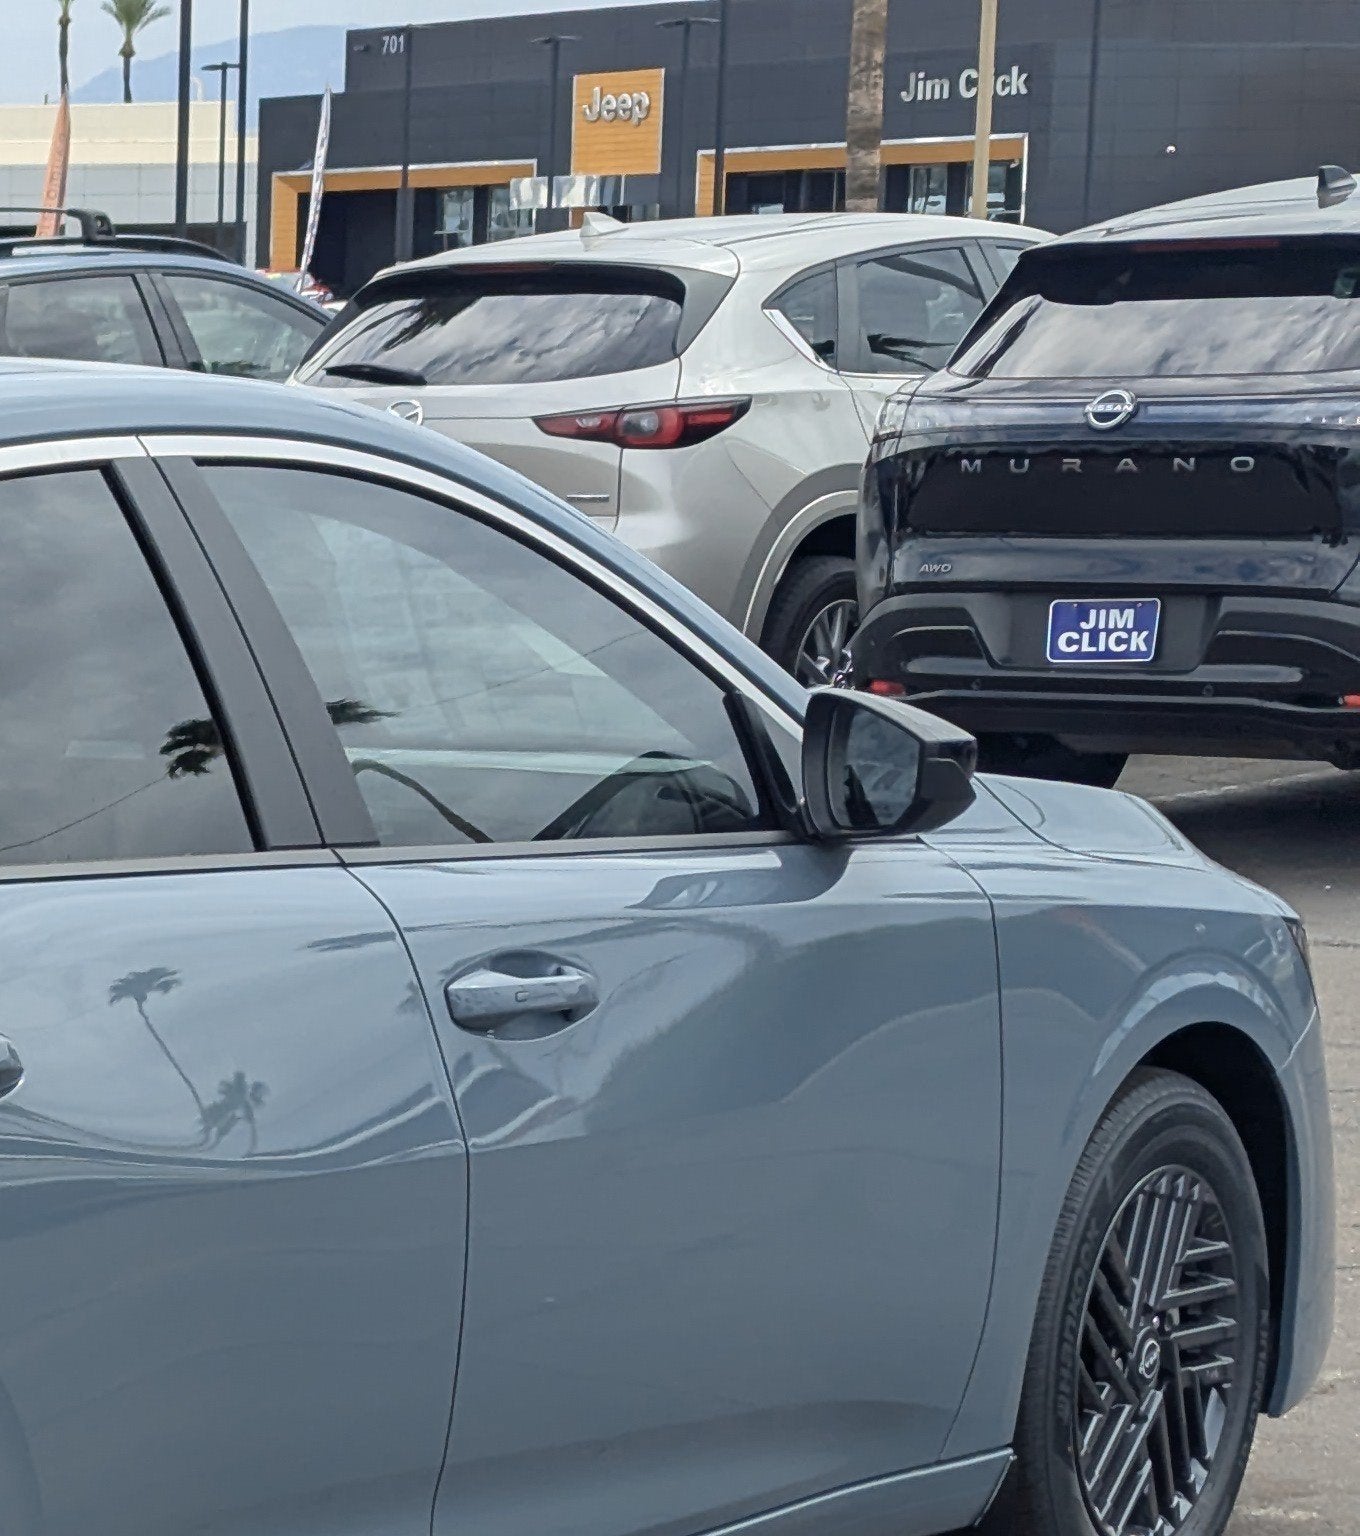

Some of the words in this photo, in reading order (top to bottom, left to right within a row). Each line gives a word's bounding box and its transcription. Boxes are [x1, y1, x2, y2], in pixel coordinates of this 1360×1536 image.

[382, 34, 404, 55] 701
[900, 71, 951, 102] Jim
[958, 65, 1029, 99] Cck
[582, 86, 650, 127] Jeep
[1084, 402, 1134, 413] NISSAN
[960, 456, 1256, 473] MURANO
[919, 563, 952, 573] AWD
[1080, 608, 1135, 630] JIM
[1057, 630, 1149, 653] CLICK
